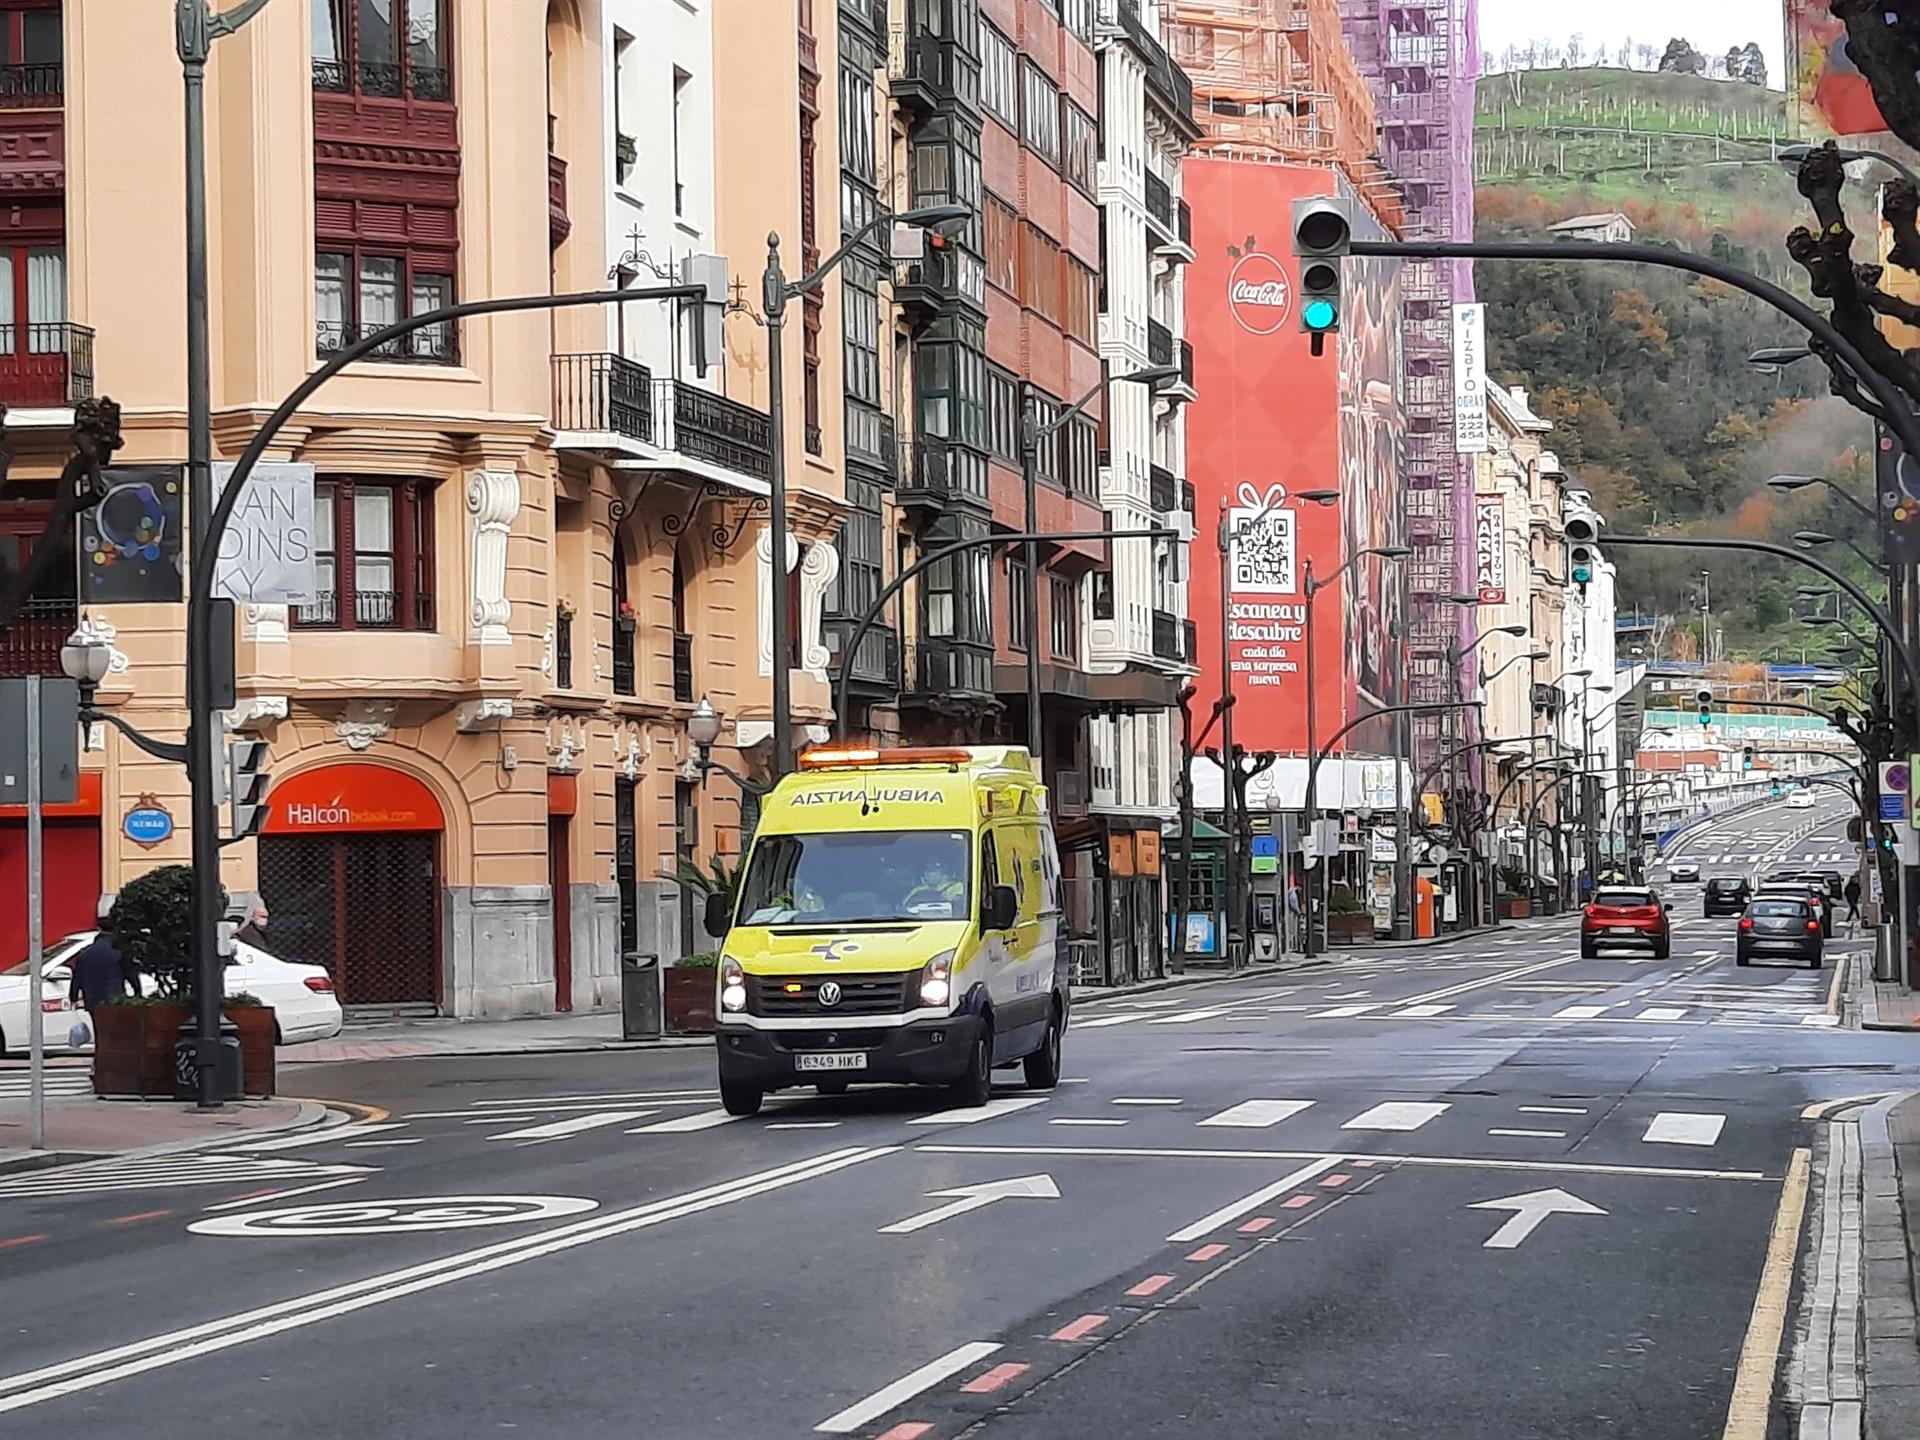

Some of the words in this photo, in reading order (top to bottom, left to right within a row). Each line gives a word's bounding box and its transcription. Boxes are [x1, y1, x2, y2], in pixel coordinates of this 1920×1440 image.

[1459, 421, 1484, 430] 222
[216, 567, 264, 600] KY
[1294, 605, 1306, 624] y
[288, 796, 350, 824] Halcón
